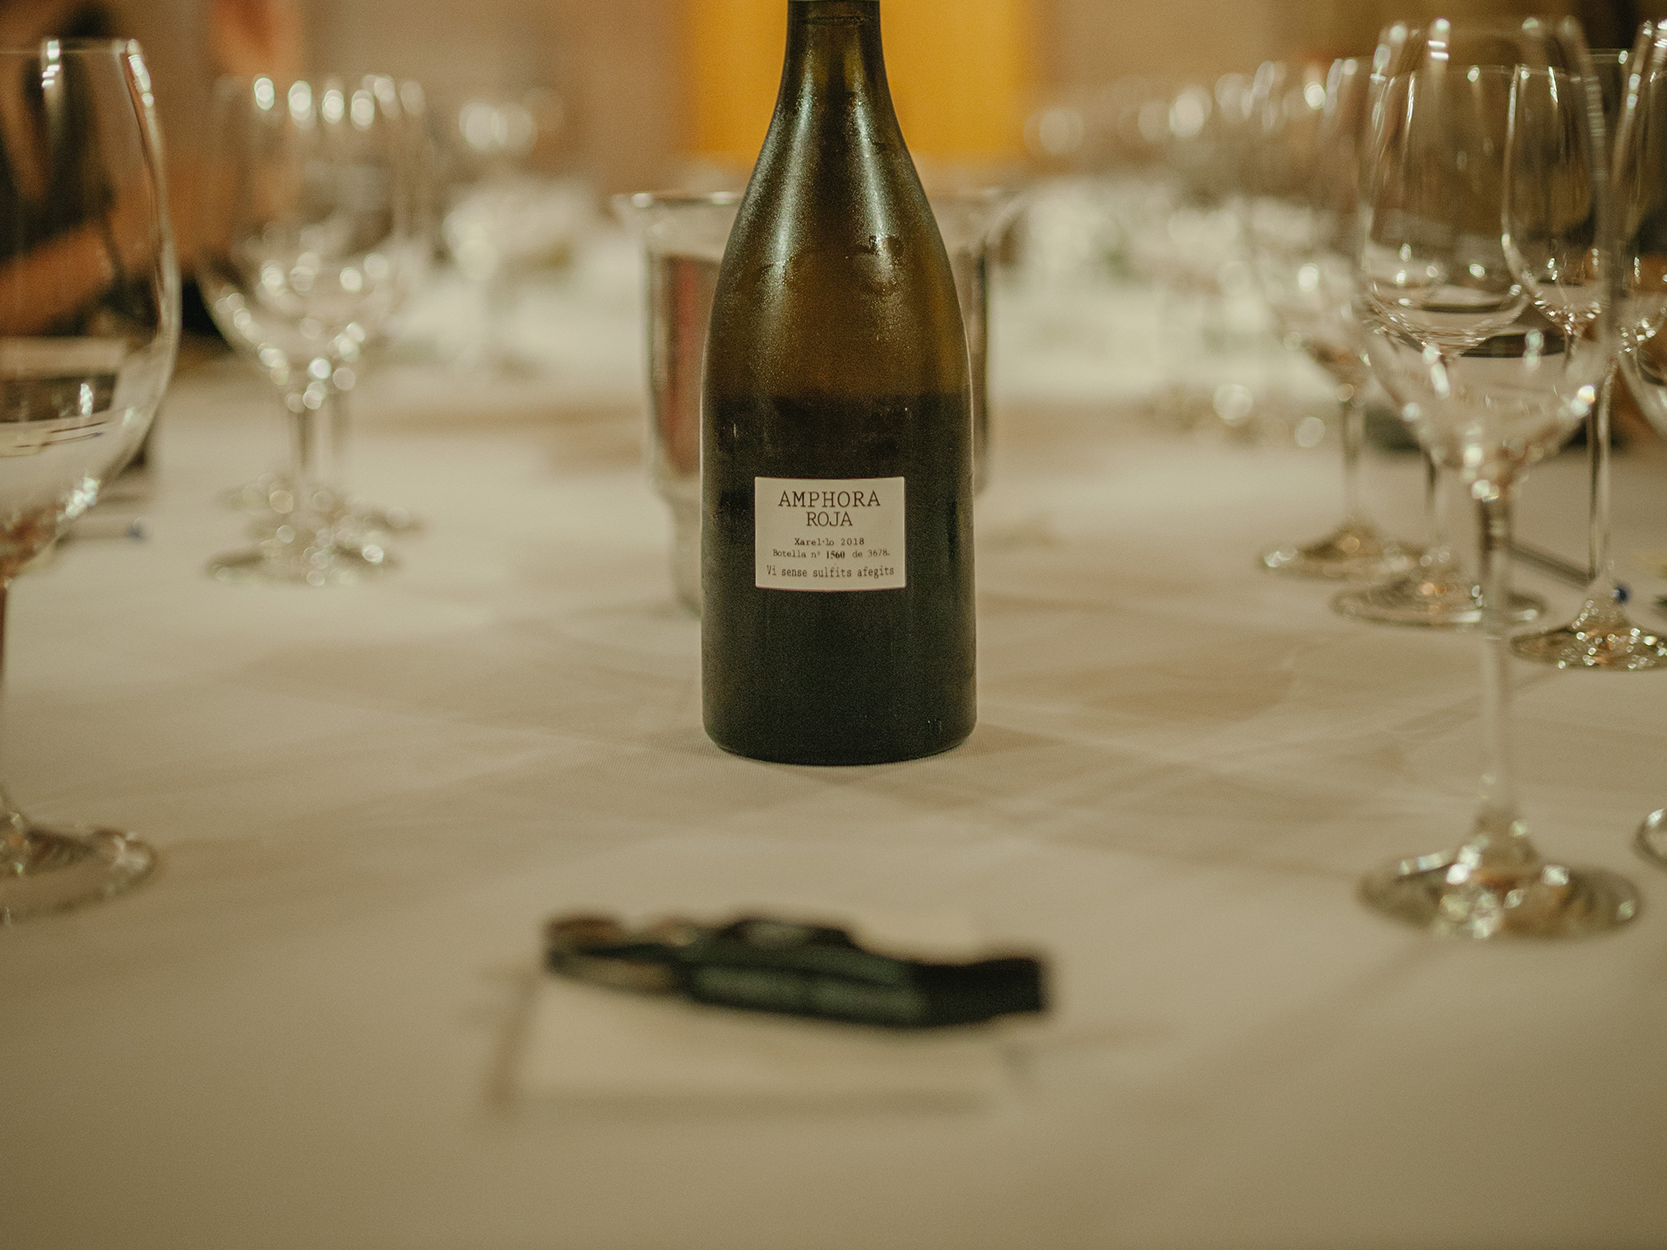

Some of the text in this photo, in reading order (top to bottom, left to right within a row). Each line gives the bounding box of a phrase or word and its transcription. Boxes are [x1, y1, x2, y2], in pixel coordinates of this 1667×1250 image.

[778, 490, 881, 508] AMPHORA
[806, 511, 853, 527] ROJA
[840, 537, 865, 546] 2018
[772, 549, 806, 558] Botella
[852, 550, 863, 558] de
[766, 565, 894, 579] Vi sense sulfits afegits
